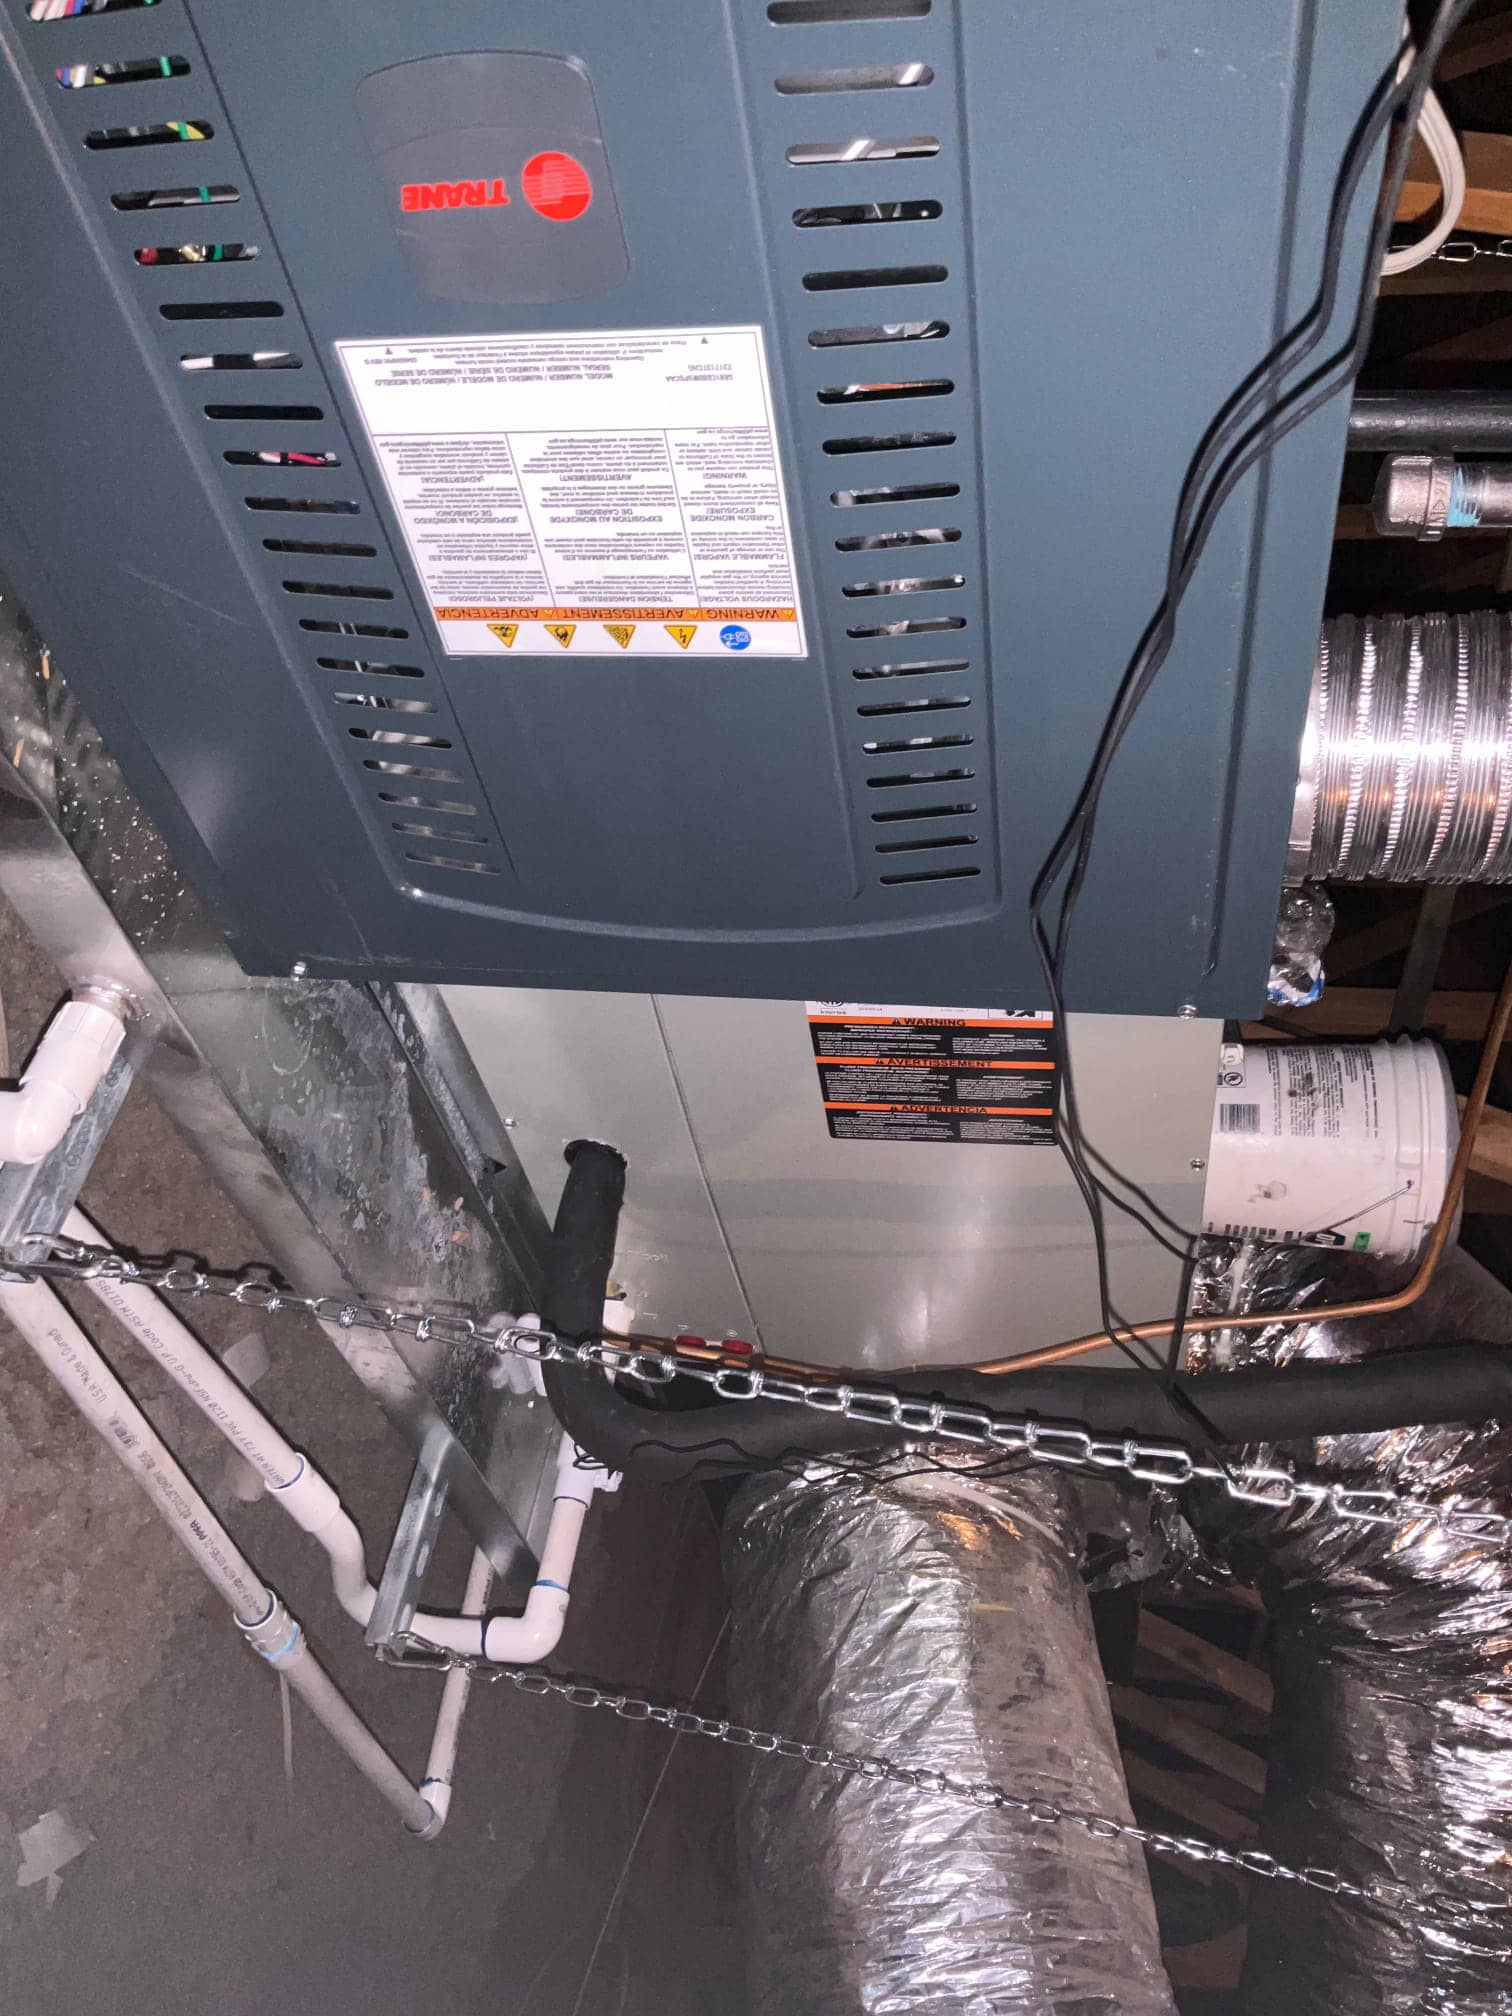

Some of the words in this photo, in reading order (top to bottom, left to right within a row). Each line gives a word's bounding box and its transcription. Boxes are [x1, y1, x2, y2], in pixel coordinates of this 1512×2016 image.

[401, 178, 509, 212] TRANE
[437, 609, 538, 618] ADVERTENCIA
[563, 608, 684, 618] AVERTISSEMENT
[707, 610, 780, 618] WARNING
[903, 1018, 966, 1026] WARNING
[888, 1058, 992, 1068] AVERTISSEMENT
[902, 1105, 987, 1113] ADVERTENCIA
[44, 1326, 74, 1358] Owned
[139, 1325, 165, 1351] Code
[69, 1359, 94, 1385] Made
[85, 1380, 108, 1405] USA
[188, 1518, 208, 1541] PPFA
